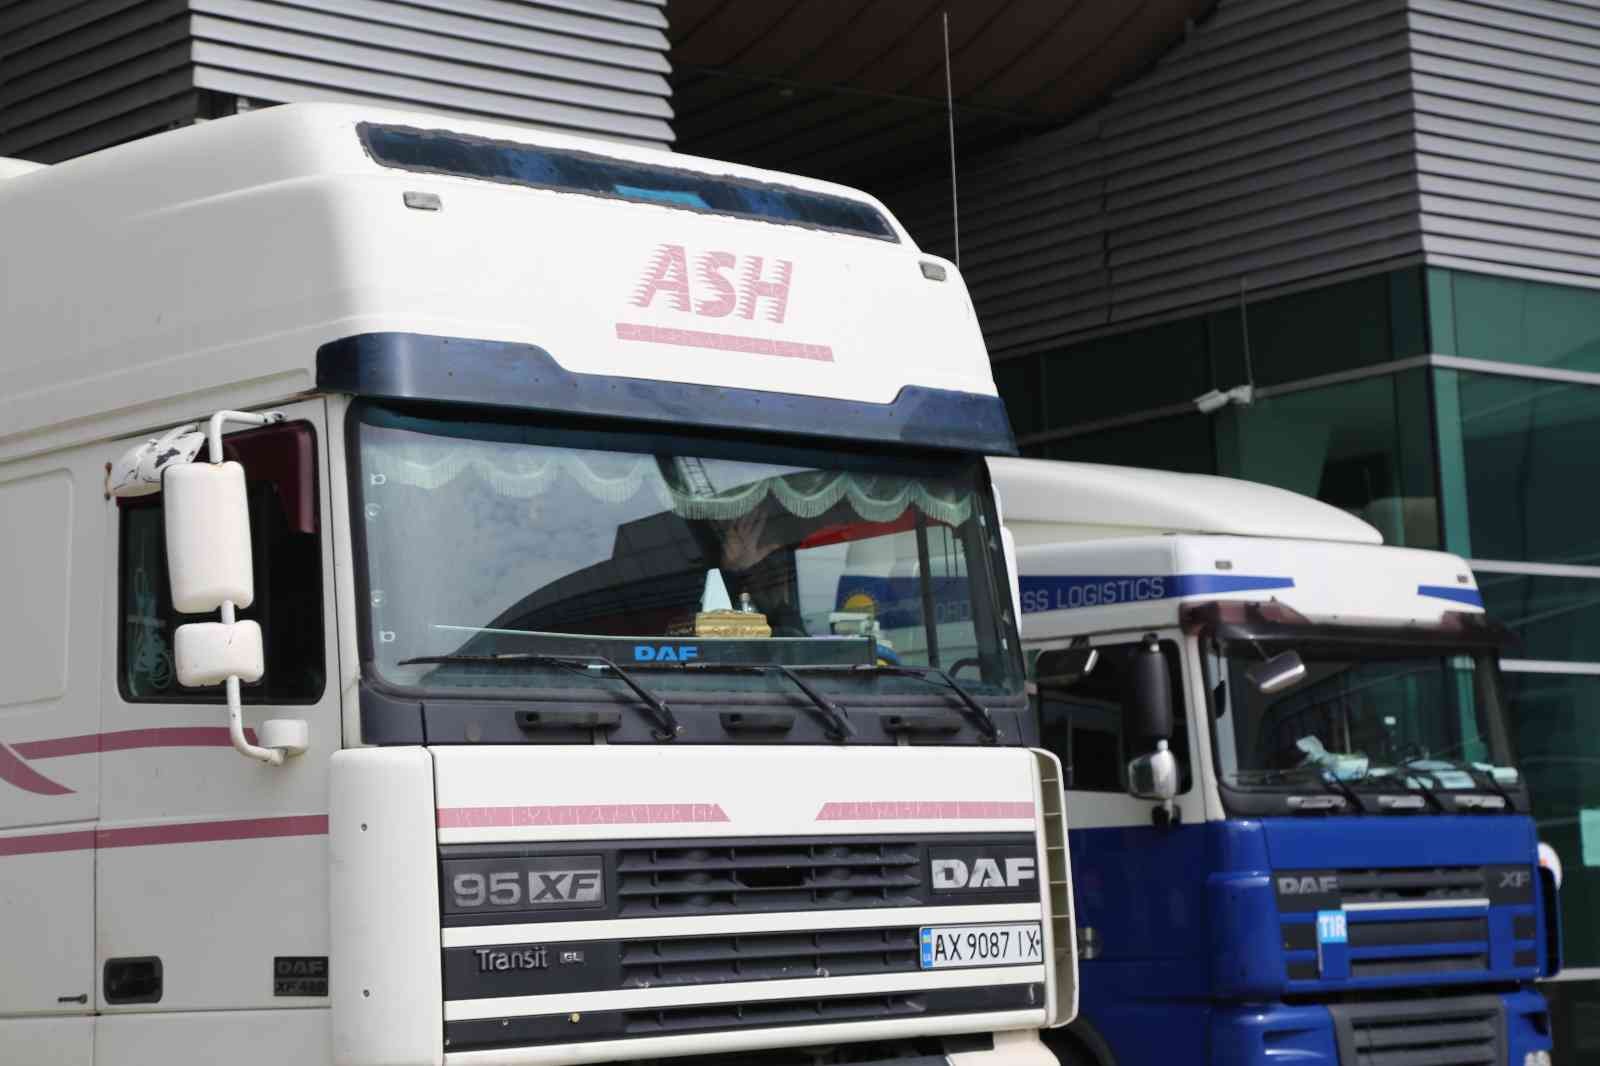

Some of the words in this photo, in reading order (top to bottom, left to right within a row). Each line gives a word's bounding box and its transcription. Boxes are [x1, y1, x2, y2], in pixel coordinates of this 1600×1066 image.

[628, 243, 793, 324] ASH
[1020, 590, 1048, 611] SS
[1056, 576, 1165, 609] LOGISTICS
[635, 645, 698, 661] DAF
[931, 858, 1035, 888] DAF
[1278, 876, 1338, 894] DAF
[1500, 871, 1529, 888] XF
[1319, 914, 1346, 938] TIR
[934, 934, 962, 961] AX
[967, 931, 1009, 960] 9087
[278, 961, 323, 975] DAF
[475, 947, 549, 971] Transit
